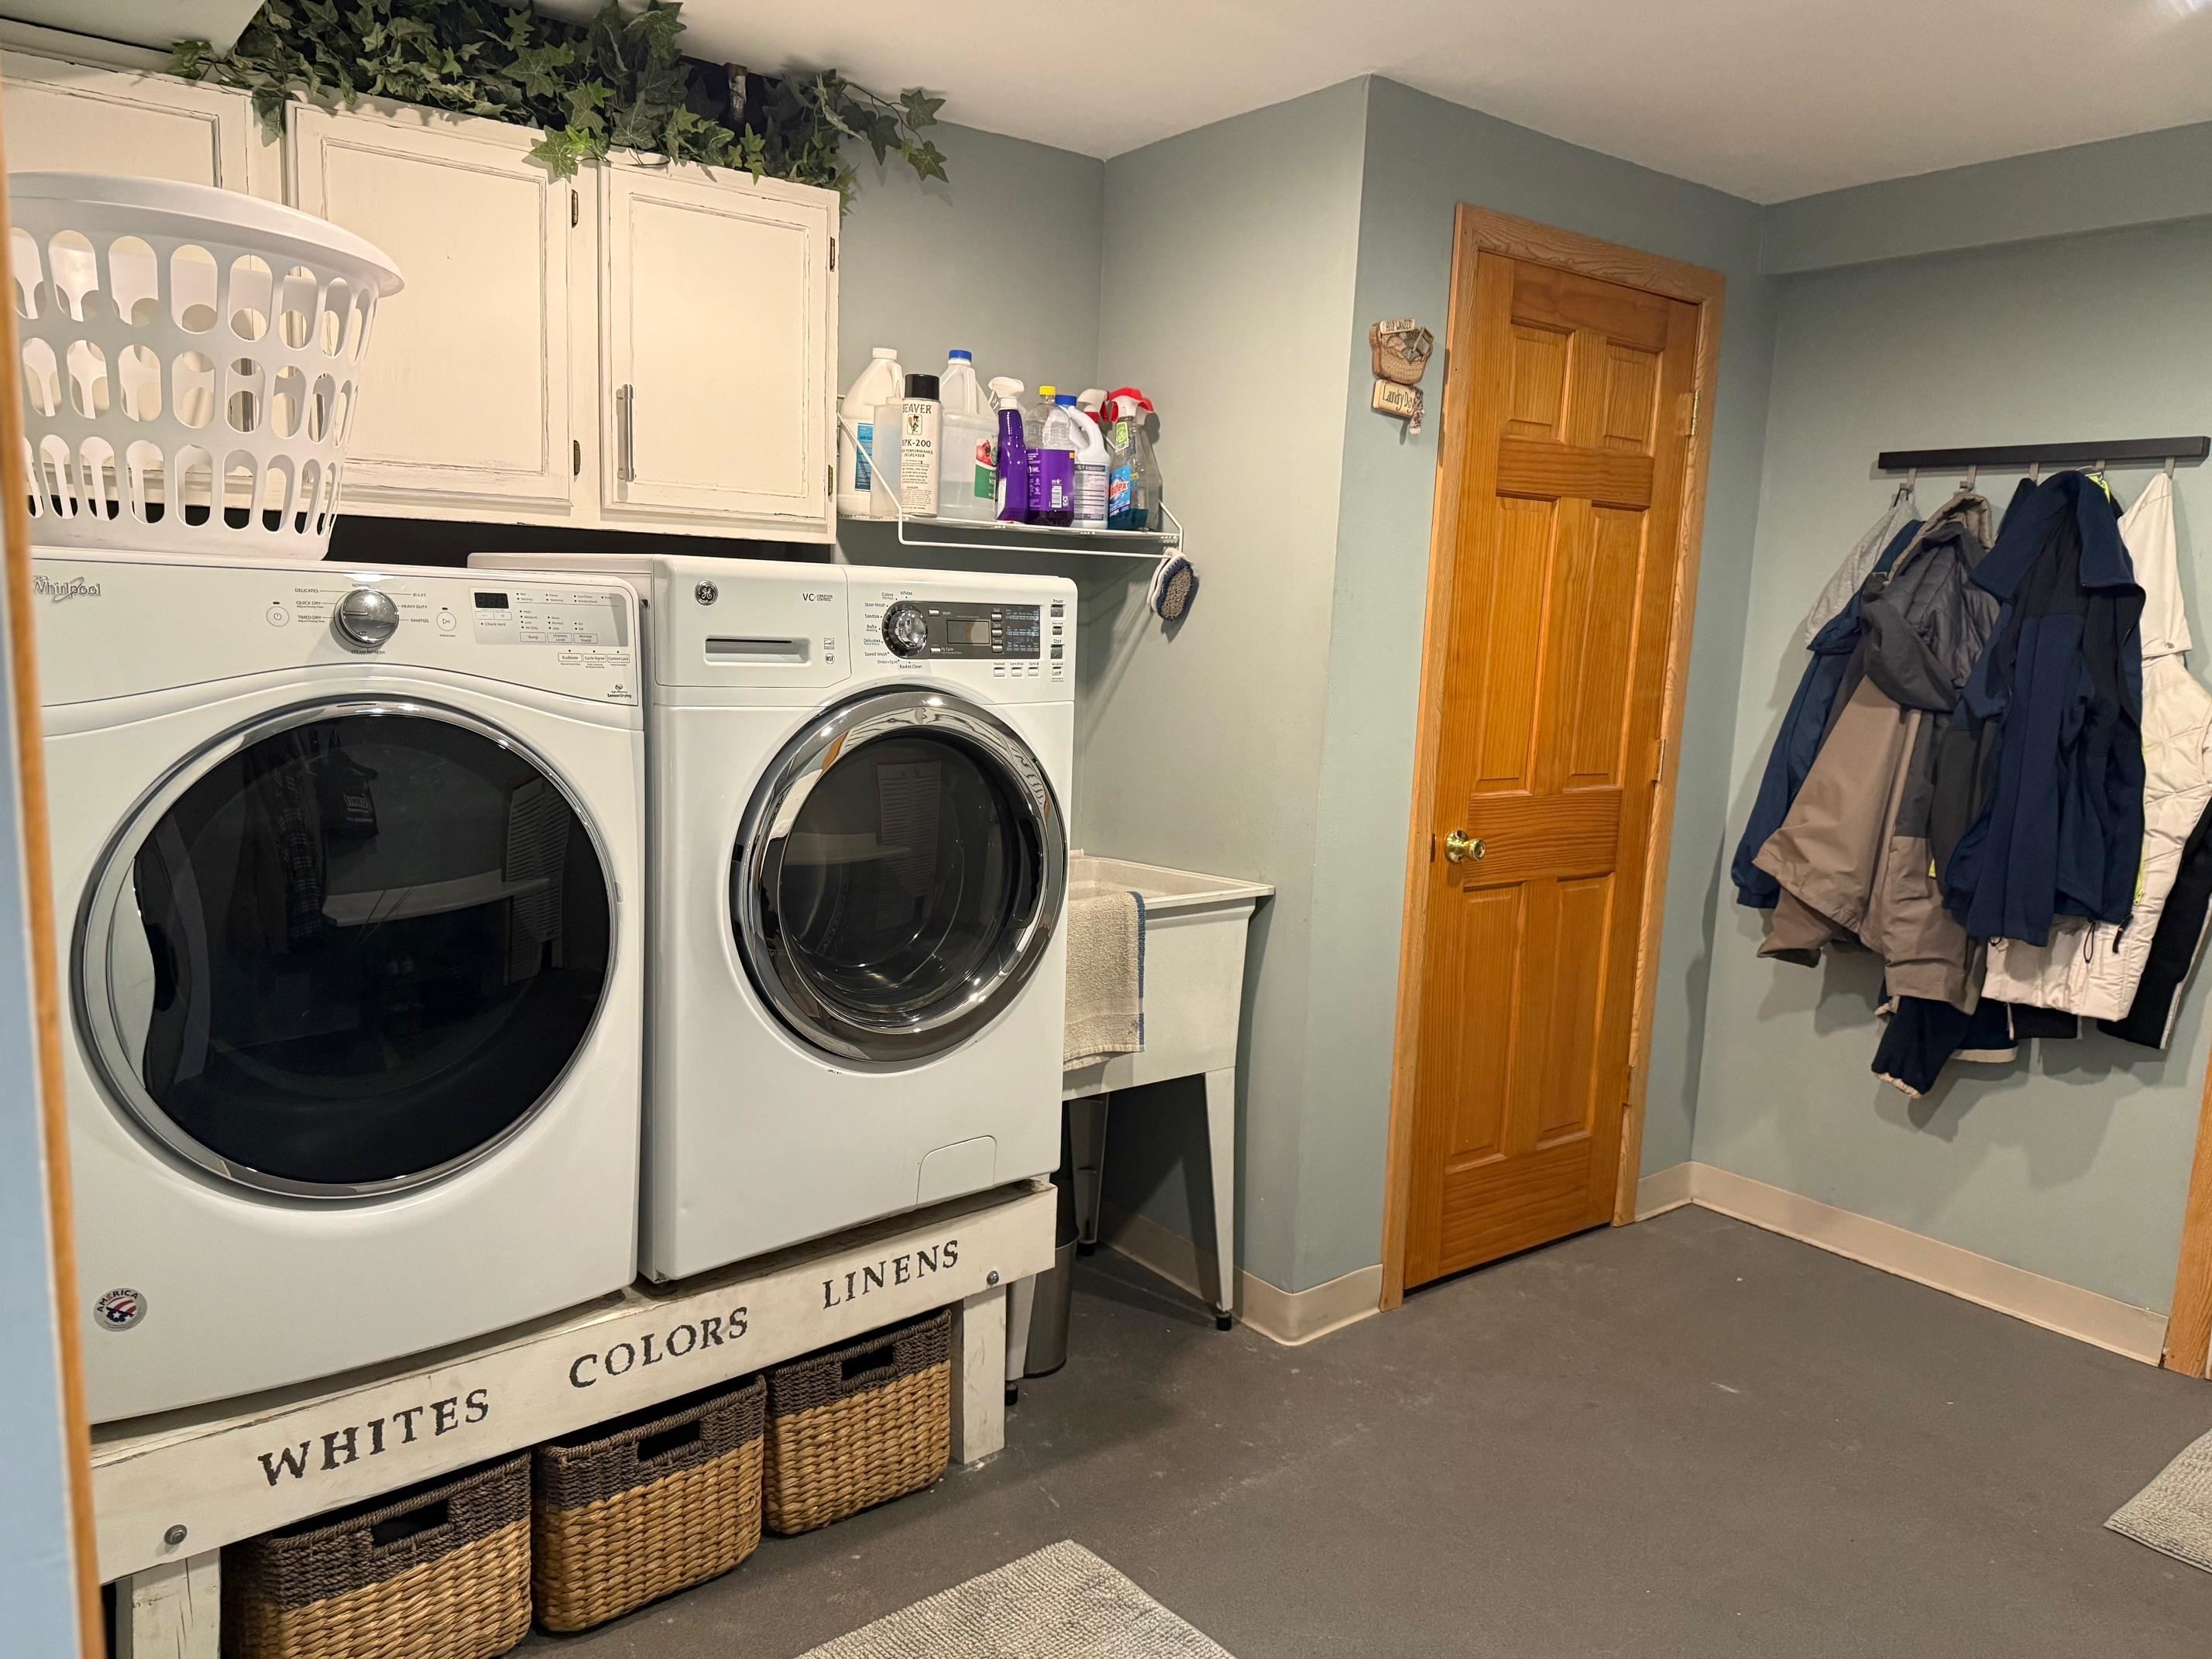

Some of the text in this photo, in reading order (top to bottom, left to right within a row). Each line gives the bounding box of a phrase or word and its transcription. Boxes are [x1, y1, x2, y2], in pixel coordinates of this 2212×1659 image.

[1382, 383, 1404, 411] Laundry
[1111, 480, 1128, 496] ndex
[33, 577, 101, 602] Whirlpool
[802, 592, 815, 602] VC
[823, 1240, 958, 1310] LINENS
[96, 1289, 139, 1313] AMERICA
[569, 1307, 747, 1388] COLORS
[257, 1389, 489, 1486] WHITES
